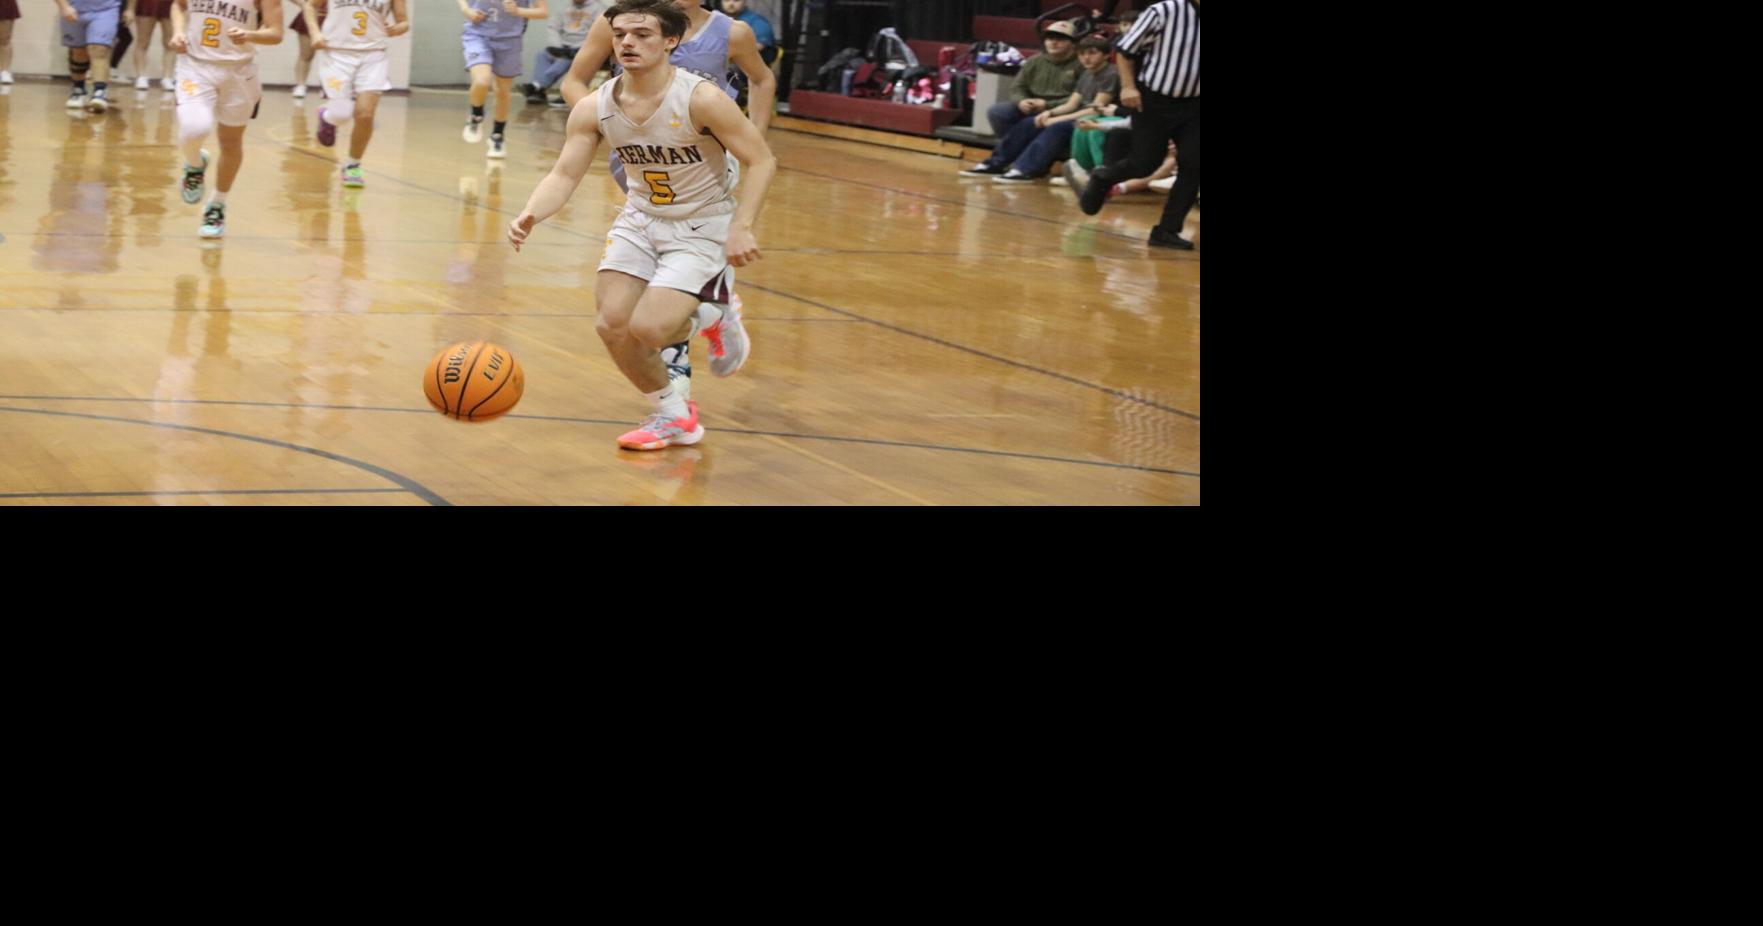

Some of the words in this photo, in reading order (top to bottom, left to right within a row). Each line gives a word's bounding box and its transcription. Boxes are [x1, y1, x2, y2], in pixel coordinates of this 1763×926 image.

[201, 17, 222, 48] 2
[352, 11, 369, 36] 3
[643, 170, 676, 205] 5
